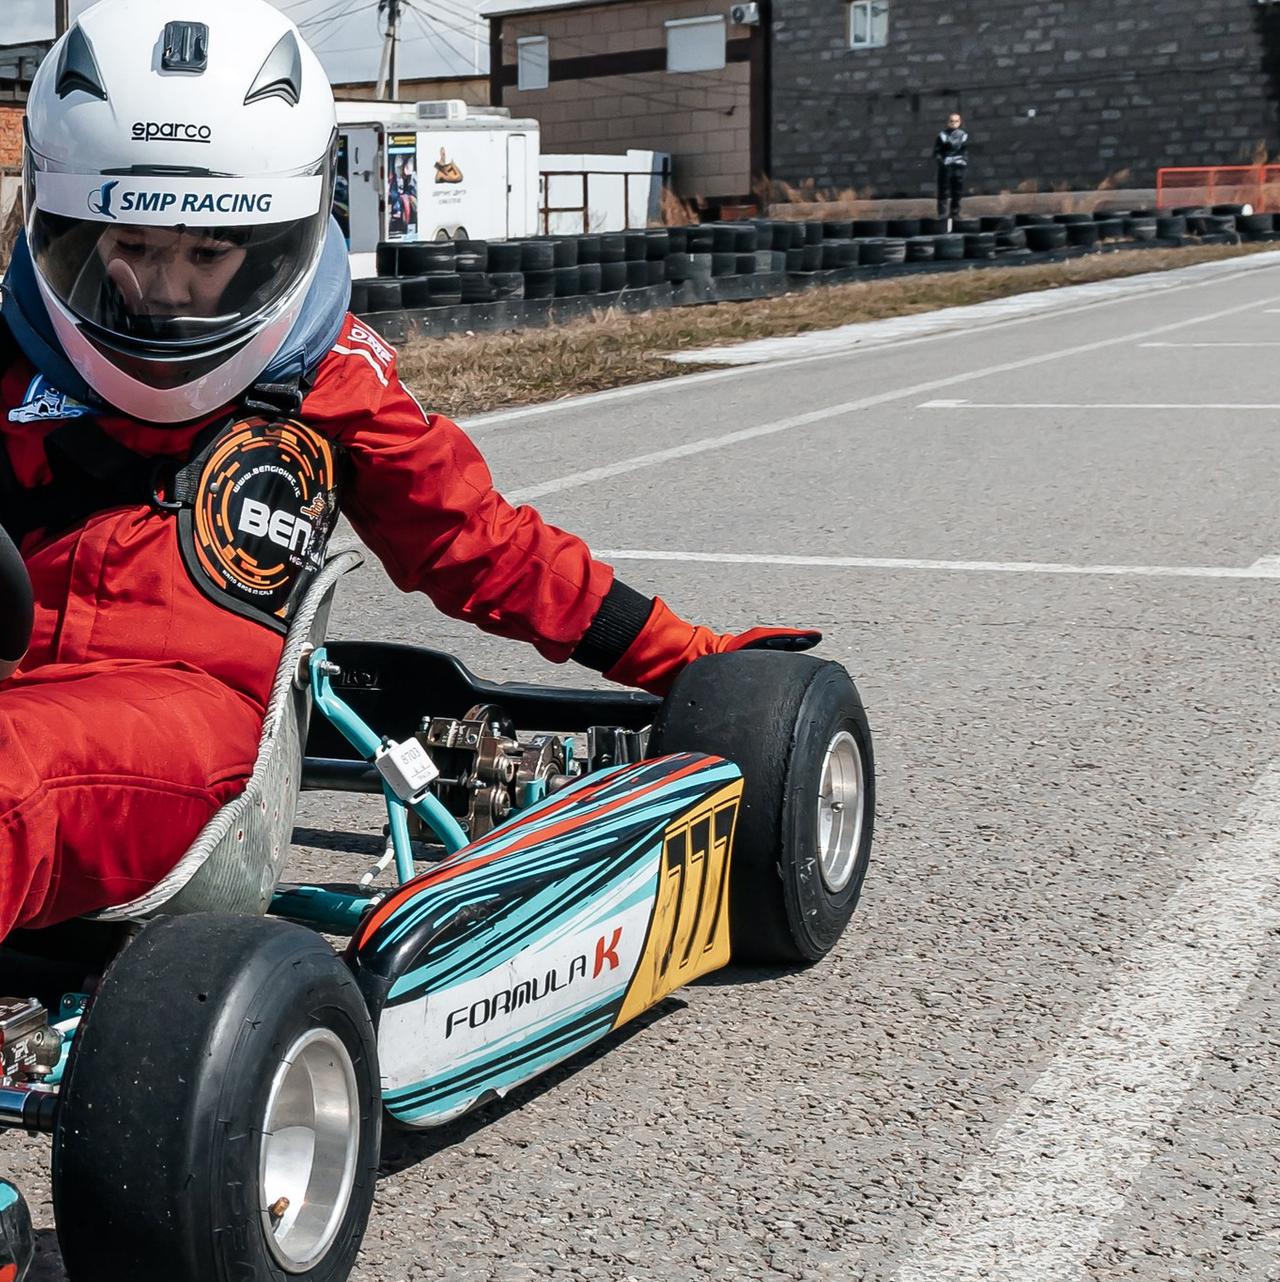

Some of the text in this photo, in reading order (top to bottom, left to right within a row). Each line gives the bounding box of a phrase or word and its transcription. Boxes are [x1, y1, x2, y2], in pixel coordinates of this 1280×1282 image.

[131, 121, 212, 143] sparco
[120, 191, 273, 213] SMP RACING
[400, 747, 421, 765] 8703
[658, 794, 741, 980] 777
[445, 926, 623, 1039] FORMULA K
